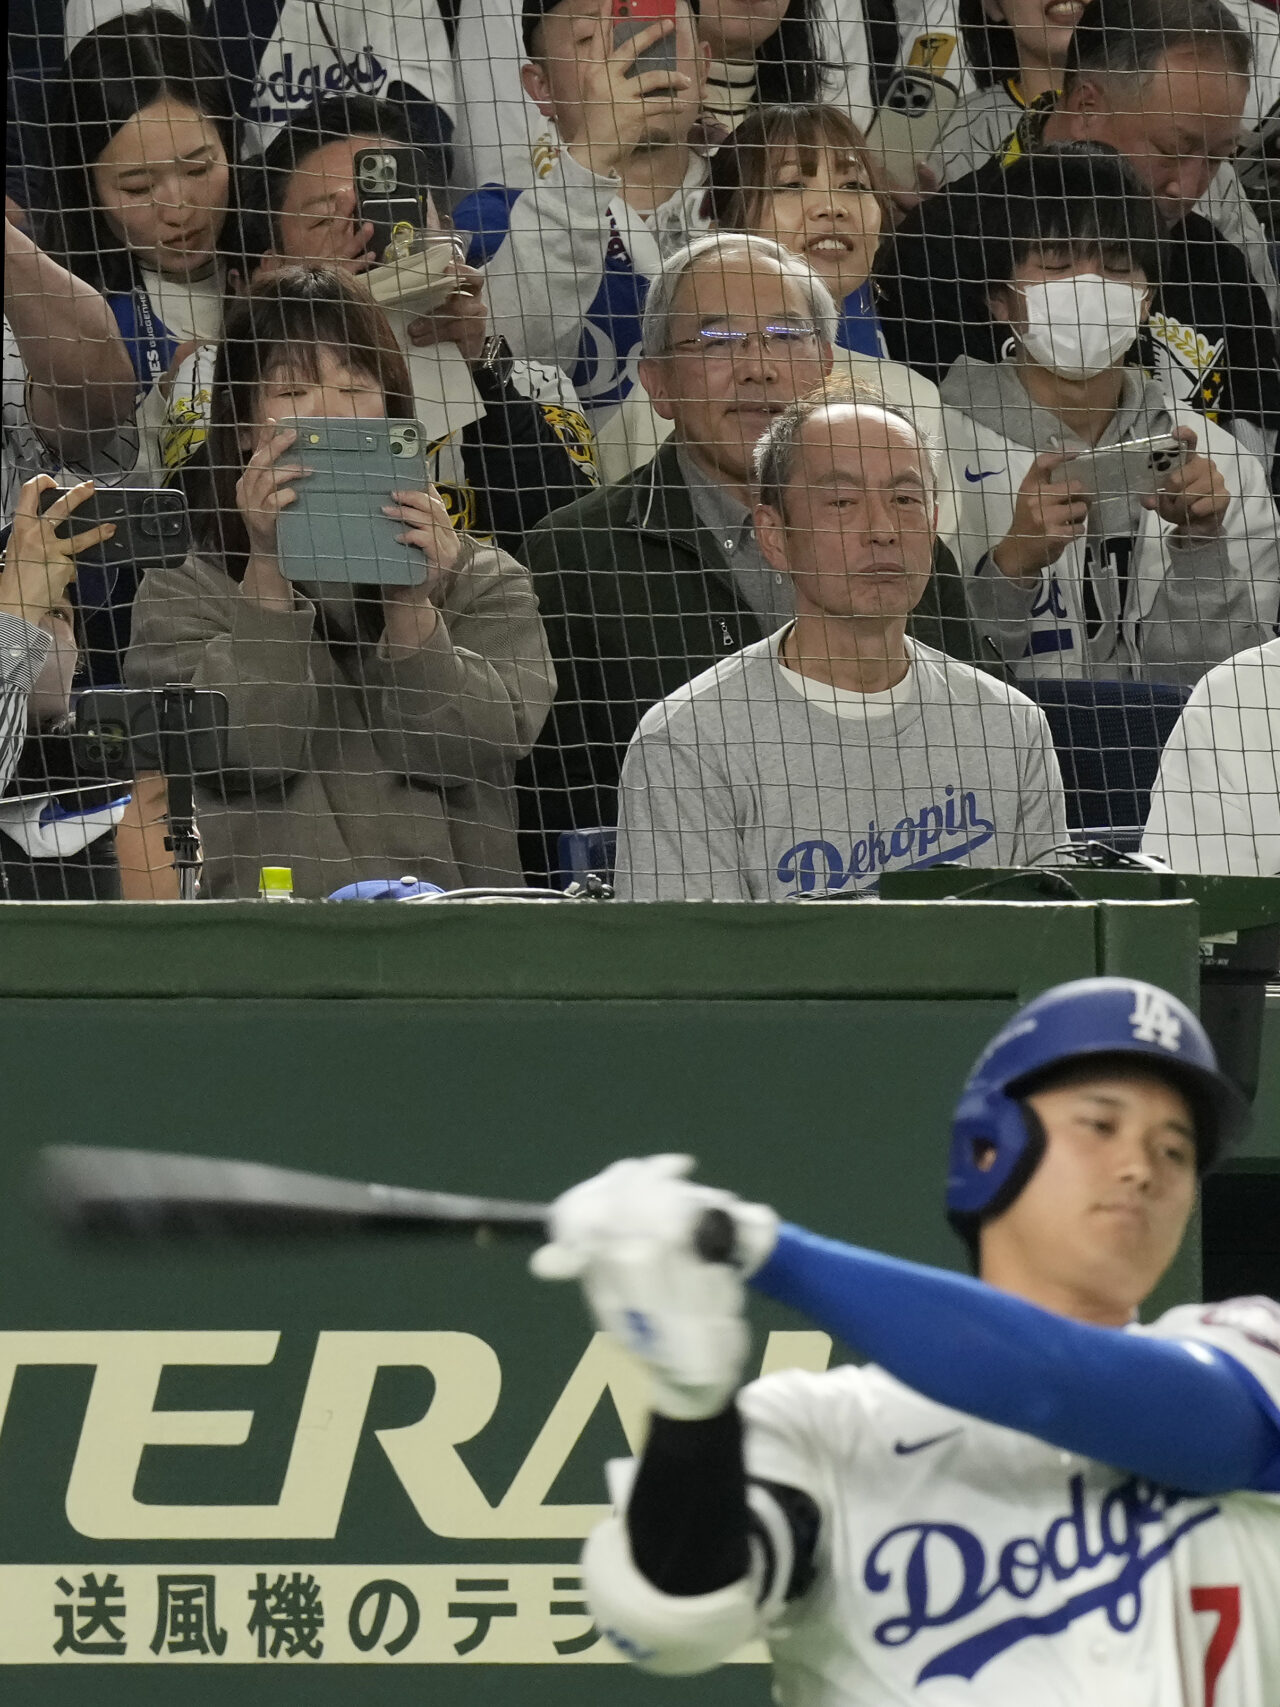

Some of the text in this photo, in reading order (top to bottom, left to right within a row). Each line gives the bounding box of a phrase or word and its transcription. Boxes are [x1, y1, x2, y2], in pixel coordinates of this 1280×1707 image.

[776, 784, 990, 898] Dekopin
[1128, 987, 1181, 1053] LA
[0, 1330, 833, 1539] ERA
[863, 1472, 1190, 1647] Dodg
